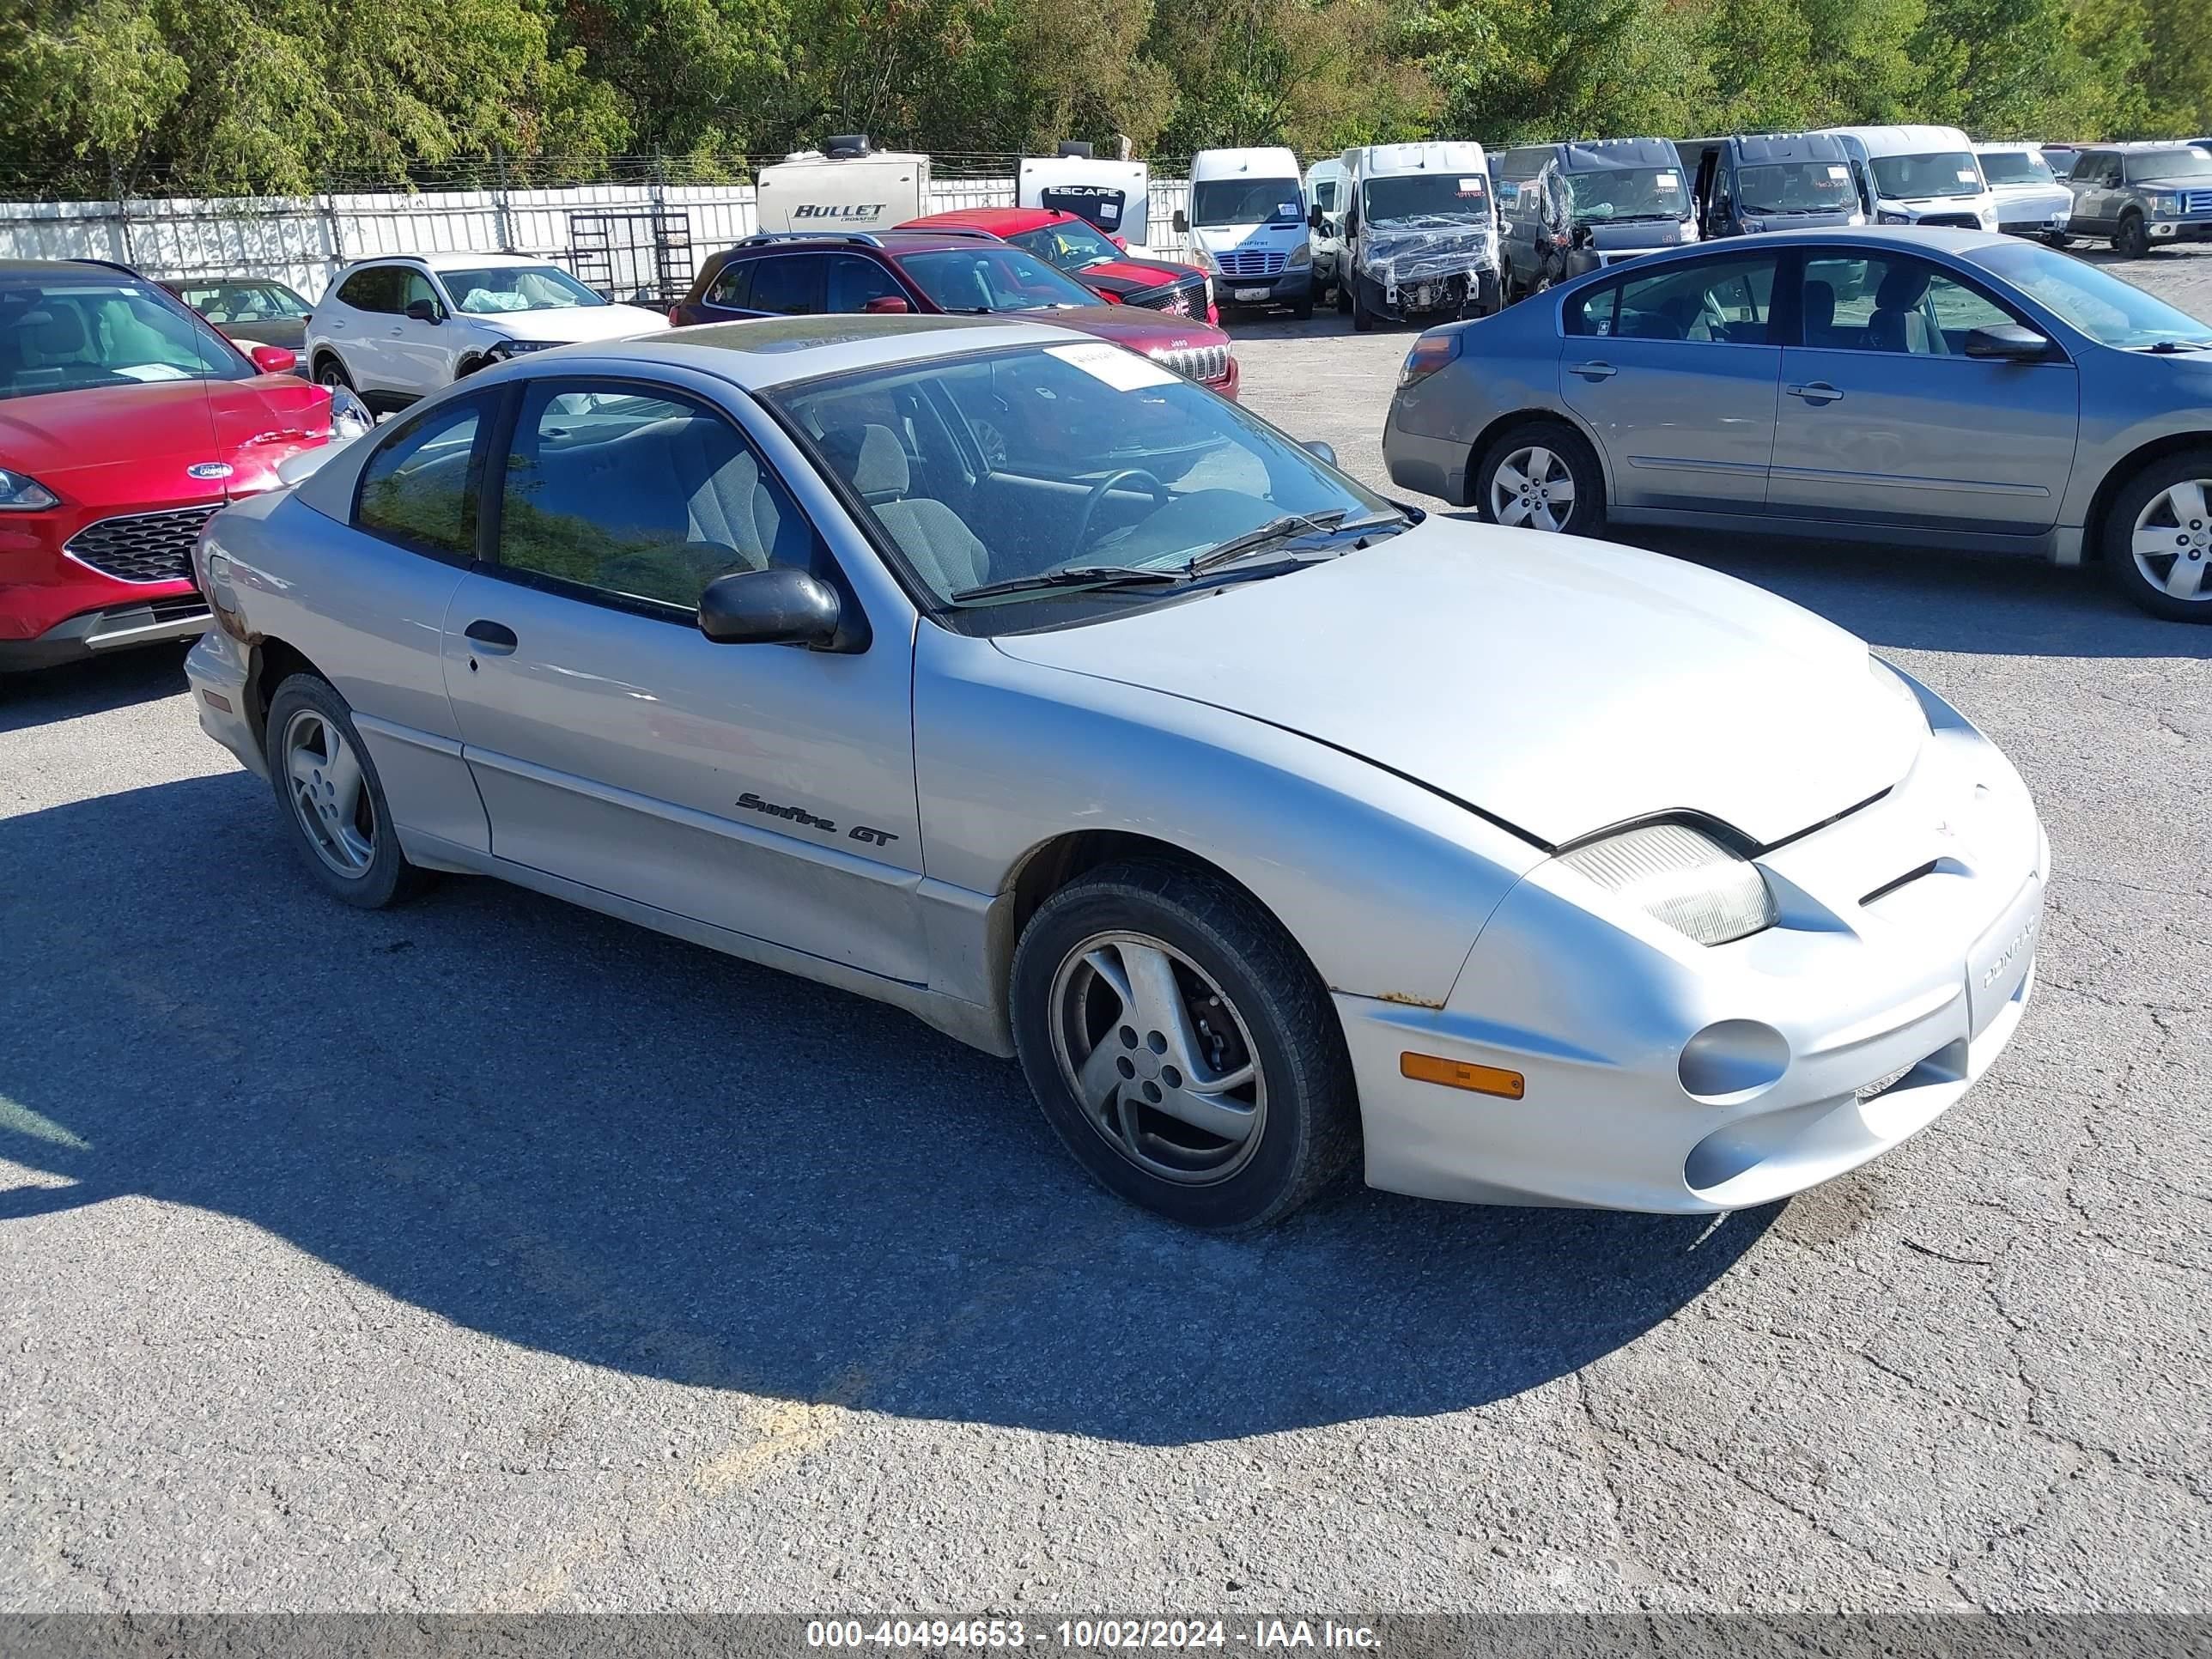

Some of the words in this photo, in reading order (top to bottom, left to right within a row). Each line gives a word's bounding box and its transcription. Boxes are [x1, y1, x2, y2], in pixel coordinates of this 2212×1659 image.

[1048, 187, 1120, 197] ESCAPE
[792, 204, 886, 218] BULLET
[1170, 338, 1188, 347] Jeep
[735, 793, 837, 833] Sunfire
[848, 826, 899, 847] GT
[1983, 913, 2035, 989] PONTIAC
